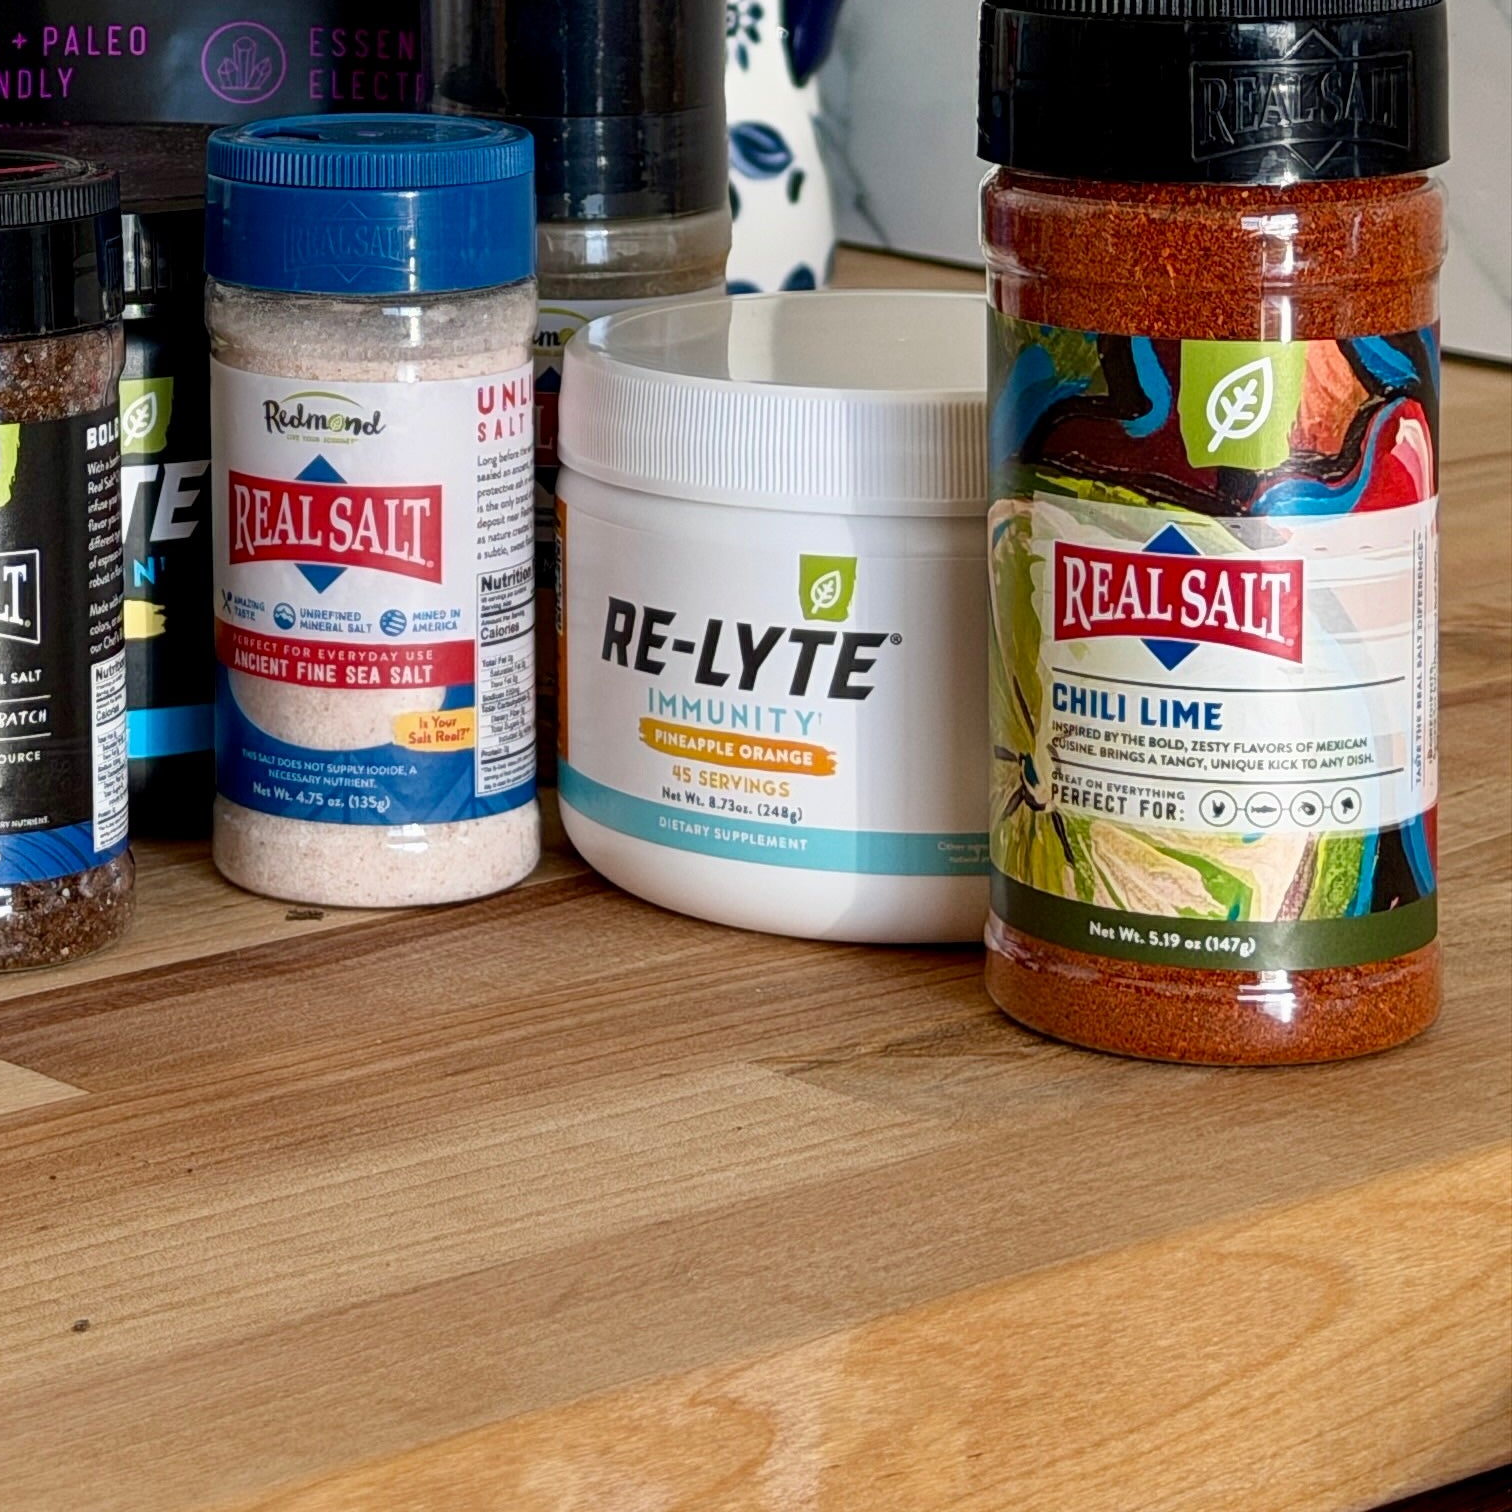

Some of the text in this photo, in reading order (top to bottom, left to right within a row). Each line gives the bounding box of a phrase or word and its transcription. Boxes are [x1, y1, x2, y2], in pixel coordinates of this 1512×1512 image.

[42, 24, 148, 58] PALEO
[1198, 64, 1402, 144] REAL SALT
[262, 399, 387, 436] Redmond
[233, 483, 432, 567] REAL SALT
[233, 595, 266, 613] AMAZING
[299, 607, 363, 622] UNREFINED
[1062, 555, 1294, 642] REAL SALT
[299, 619, 373, 634] MINERAL SALT
[411, 620, 459, 632] AMERICA
[233, 648, 434, 685] ANCIENT FINE SEA SALT
[283, 644, 312, 659] FOR
[317, 648, 399, 662] EVERYDAY
[405, 649, 434, 661] USE
[10, 668, 43, 685] SALT
[1051, 681, 1224, 732] CHILI LIME
[653, 728, 815, 767] PINEAPPLE ORANGE
[1051, 719, 1368, 755] INSPIRED BY THE BOLD, ZESTY FLAVORS OF MEXICAN
[1099, 746, 1146, 764] BRINGS
[1147, 753, 1158, 766] A
[1159, 754, 1208, 772] TANGY,
[1210, 757, 1265, 772] UNIQUE
[1267, 757, 1299, 771] KICK
[1300, 757, 1319, 770] TO
[1319, 755, 1345, 769] ANY
[1346, 751, 1375, 767] DISH.
[671, 764, 791, 798] 45 SERVINGS
[1051, 769, 1186, 801] GREAT ON EVERYTHING
[1050, 783, 1186, 822] PERFECT FOR:
[658, 815, 808, 852] DIETARY SUPPLEMENT
[1088, 919, 1257, 958] Net Wt. 5.19 oz (147g)
